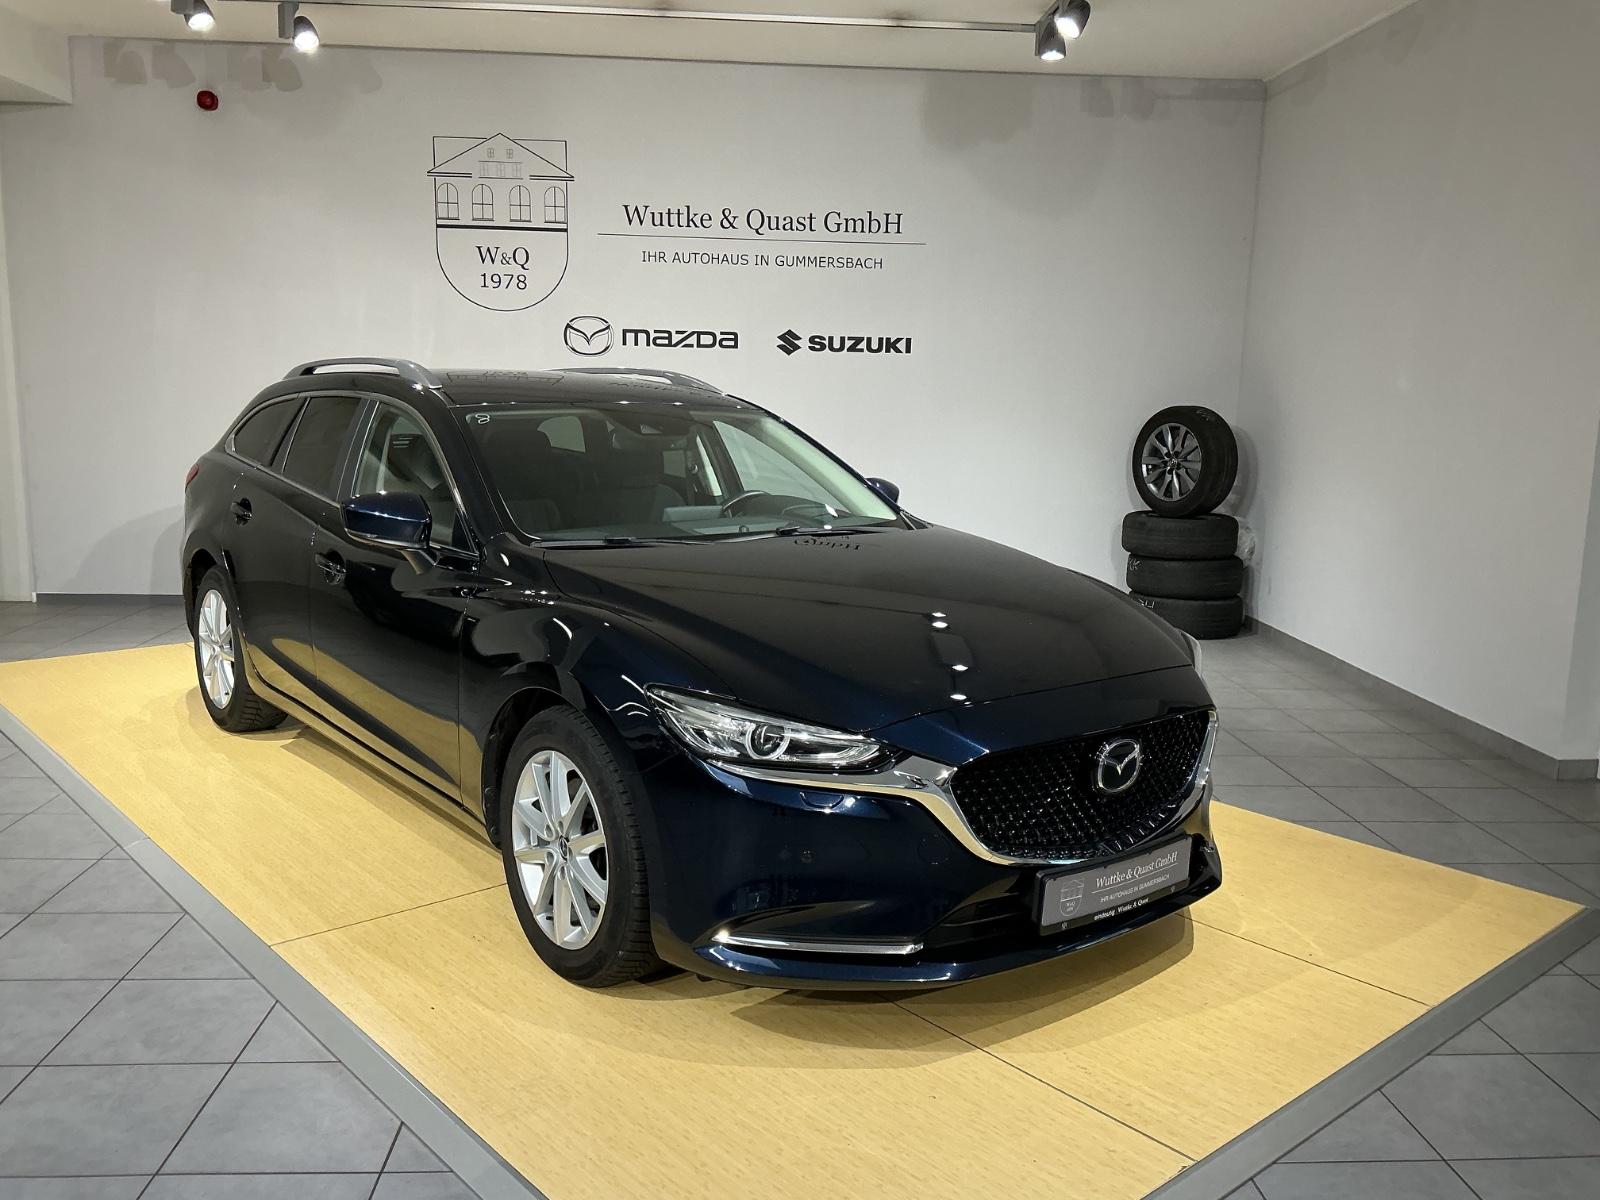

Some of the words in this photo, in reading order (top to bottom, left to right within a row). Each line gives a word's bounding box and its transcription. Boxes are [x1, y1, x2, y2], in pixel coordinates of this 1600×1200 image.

[622, 204, 713, 229] Wuttke
[719, 207, 739, 230] &
[746, 208, 817, 236] Quast
[823, 210, 903, 235] GmbH
[475, 245, 530, 271] W&Q
[641, 250, 668, 264] IHR
[672, 251, 749, 266] AUTOHAUS
[754, 253, 770, 267] IN
[774, 254, 883, 270] GUMMERSBACH
[480, 272, 528, 291] 1978
[807, 335, 912, 355] SUZUKI
[1096, 872, 1126, 888] Wuttke
[1125, 868, 1134, 880] &
[1133, 865, 1155, 878] Quast
[1155, 851, 1178, 868] GmbH
